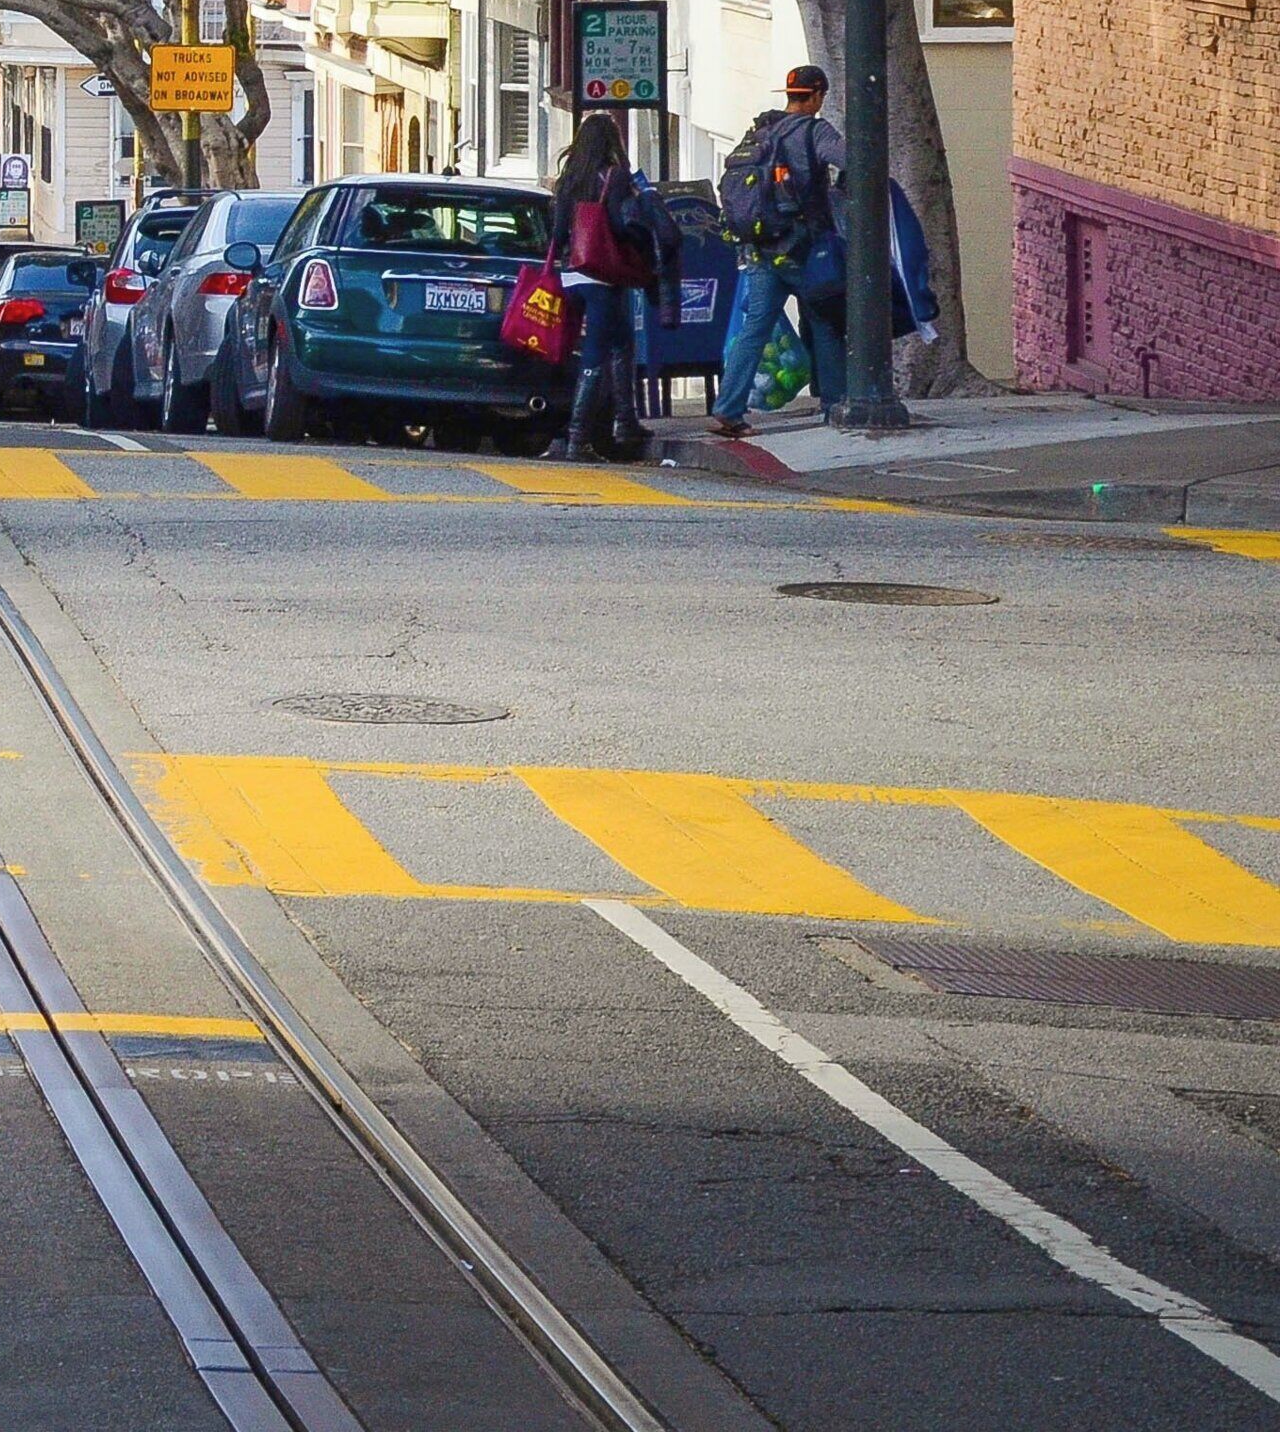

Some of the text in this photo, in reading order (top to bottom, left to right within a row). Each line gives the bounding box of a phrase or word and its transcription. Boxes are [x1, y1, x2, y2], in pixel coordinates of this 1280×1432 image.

[586, 14, 647, 33] 2 HOUR
[608, 26, 657, 36] PARKING
[173, 52, 212, 63] TRUCKS
[586, 57, 610, 67] MON
[632, 57, 651, 67] FRI
[157, 71, 228, 82] NOT ADVISED
[592, 82, 649, 96] A C G
[154, 90, 229, 101] ON BROADWAY
[1, 192, 7, 200] 2
[83, 207, 91, 218] 2
[428, 291, 484, 310] 7KMY945
[125, 1068, 299, 1084] ROPE
